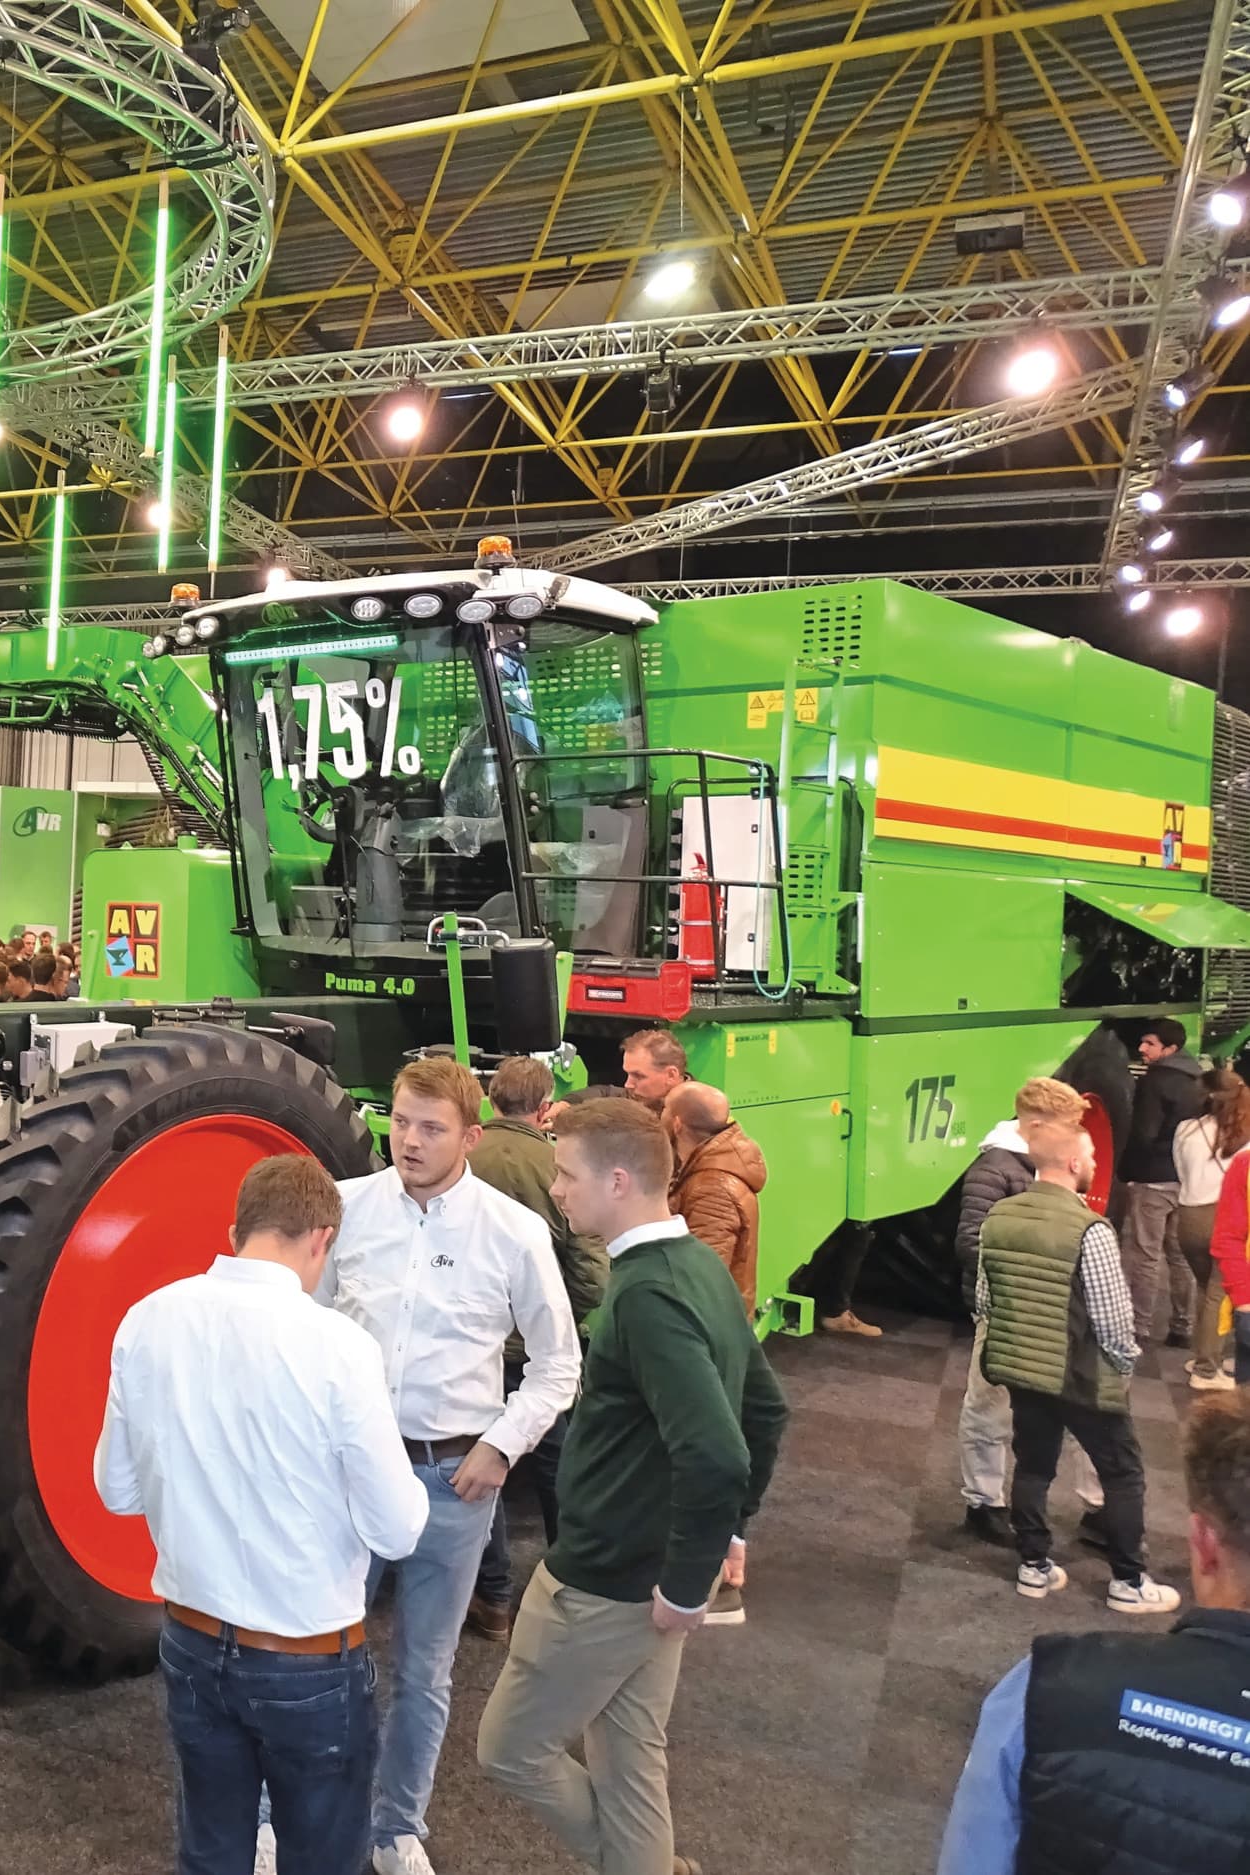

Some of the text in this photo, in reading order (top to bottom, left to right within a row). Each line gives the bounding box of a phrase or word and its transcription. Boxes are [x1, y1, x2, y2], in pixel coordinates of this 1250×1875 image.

[257, 676, 421, 791] 1,75%
[14, 807, 62, 836] AVR
[325, 972, 415, 995] Puma 4.0
[905, 1074, 956, 1143] 175
[1131, 1698, 1243, 1741] BARENDREGT
